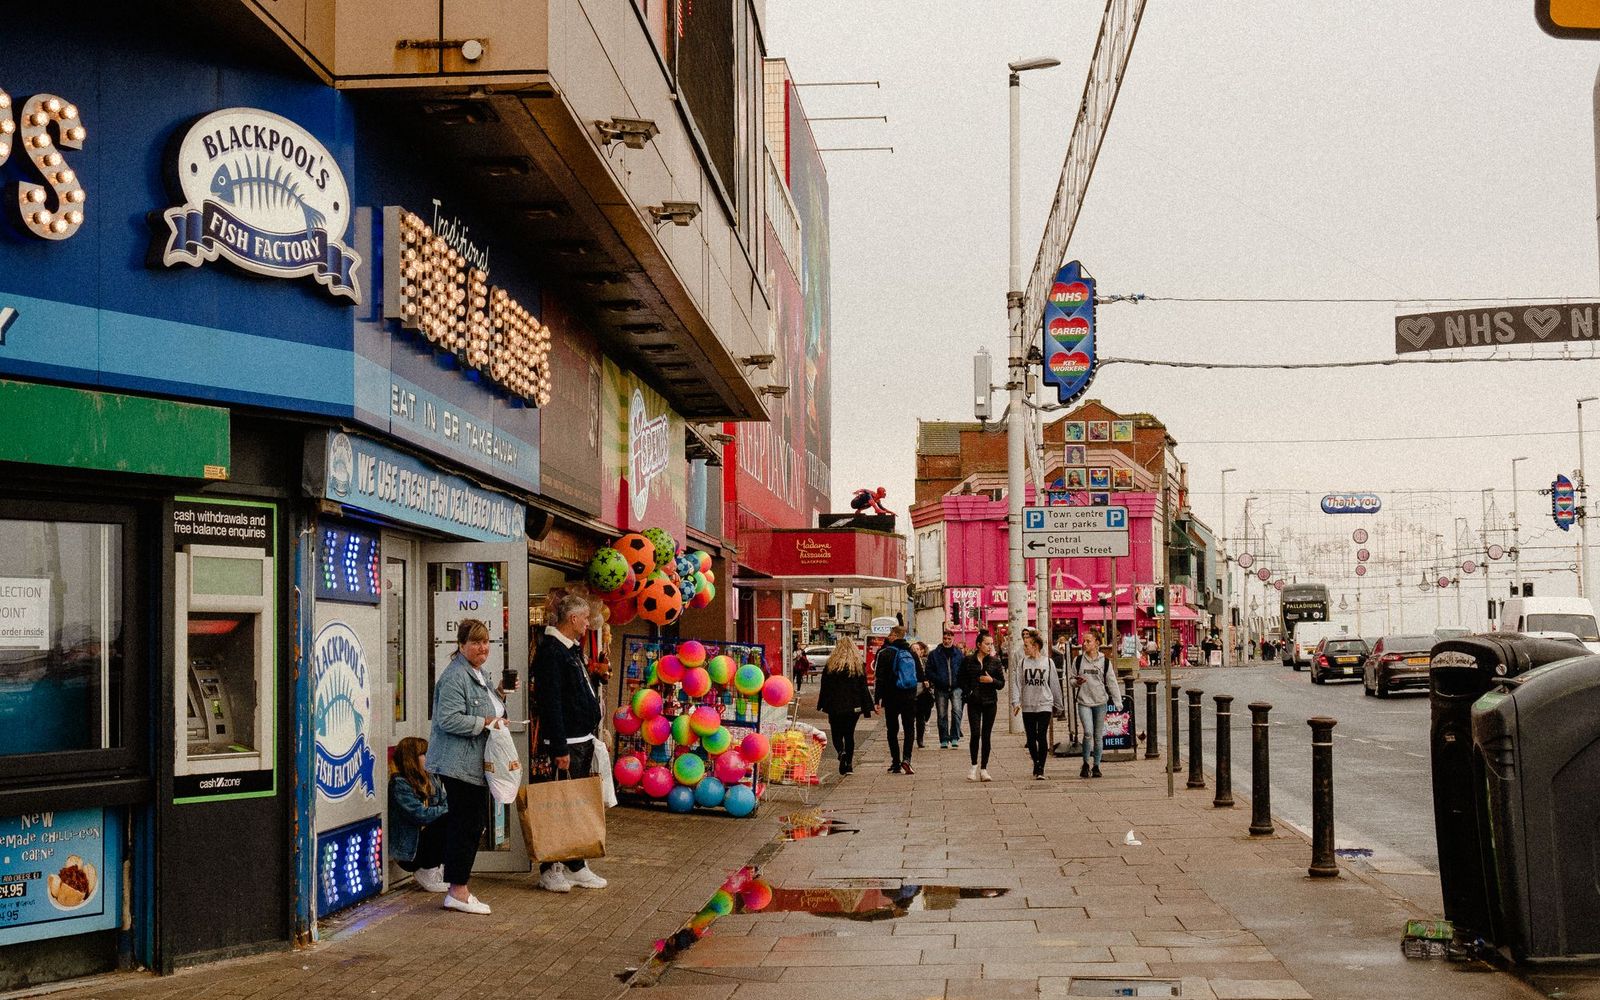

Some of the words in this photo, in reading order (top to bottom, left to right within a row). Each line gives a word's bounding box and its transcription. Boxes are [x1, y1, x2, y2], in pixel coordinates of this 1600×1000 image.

[202, 124, 330, 190] BLACKPOOL'S
[209, 211, 249, 252] FISH
[254, 236, 321, 263] FACTORY
[432, 198, 491, 277] Traditional
[1056, 291, 1082, 302] NHS
[1050, 327, 1088, 335] CARERS
[1445, 311, 1516, 346] NHS
[391, 384, 416, 420] EAT
[423, 400, 437, 433] IN
[443, 411, 460, 443] OR
[466, 422, 519, 469] TAKEAWAY
[357, 452, 376, 496] WE
[378, 460, 398, 503] USE
[398, 469, 429, 515] FRESH
[1327, 496, 1357, 507] Thank
[1360, 498, 1377, 508] you
[173, 510, 196, 522] cash
[197, 511, 248, 525] withdrawals
[249, 514, 266, 526] and
[1048, 510, 1071, 518] Town
[1075, 510, 1104, 518] centre
[174, 521, 191, 533] free
[193, 523, 227, 536] balance
[228, 526, 266, 540] enquiries
[1072, 521, 1097, 529] parks
[796, 538, 831, 550] Madame
[1047, 535, 1081, 543] Central
[1047, 546, 1079, 555] Chapel
[1083, 546, 1112, 554] Street
[1050, 589, 1092, 602] GIFTS
[459, 600, 479, 611] NO
[1, 627, 21, 636] order
[23, 627, 44, 636] inside
[1025, 669, 1047, 679] IVY
[1025, 678, 1045, 686] PARK
[1105, 737, 1125, 746] HERE
[315, 752, 333, 786] FISH
[333, 743, 362, 787] FACTORY
